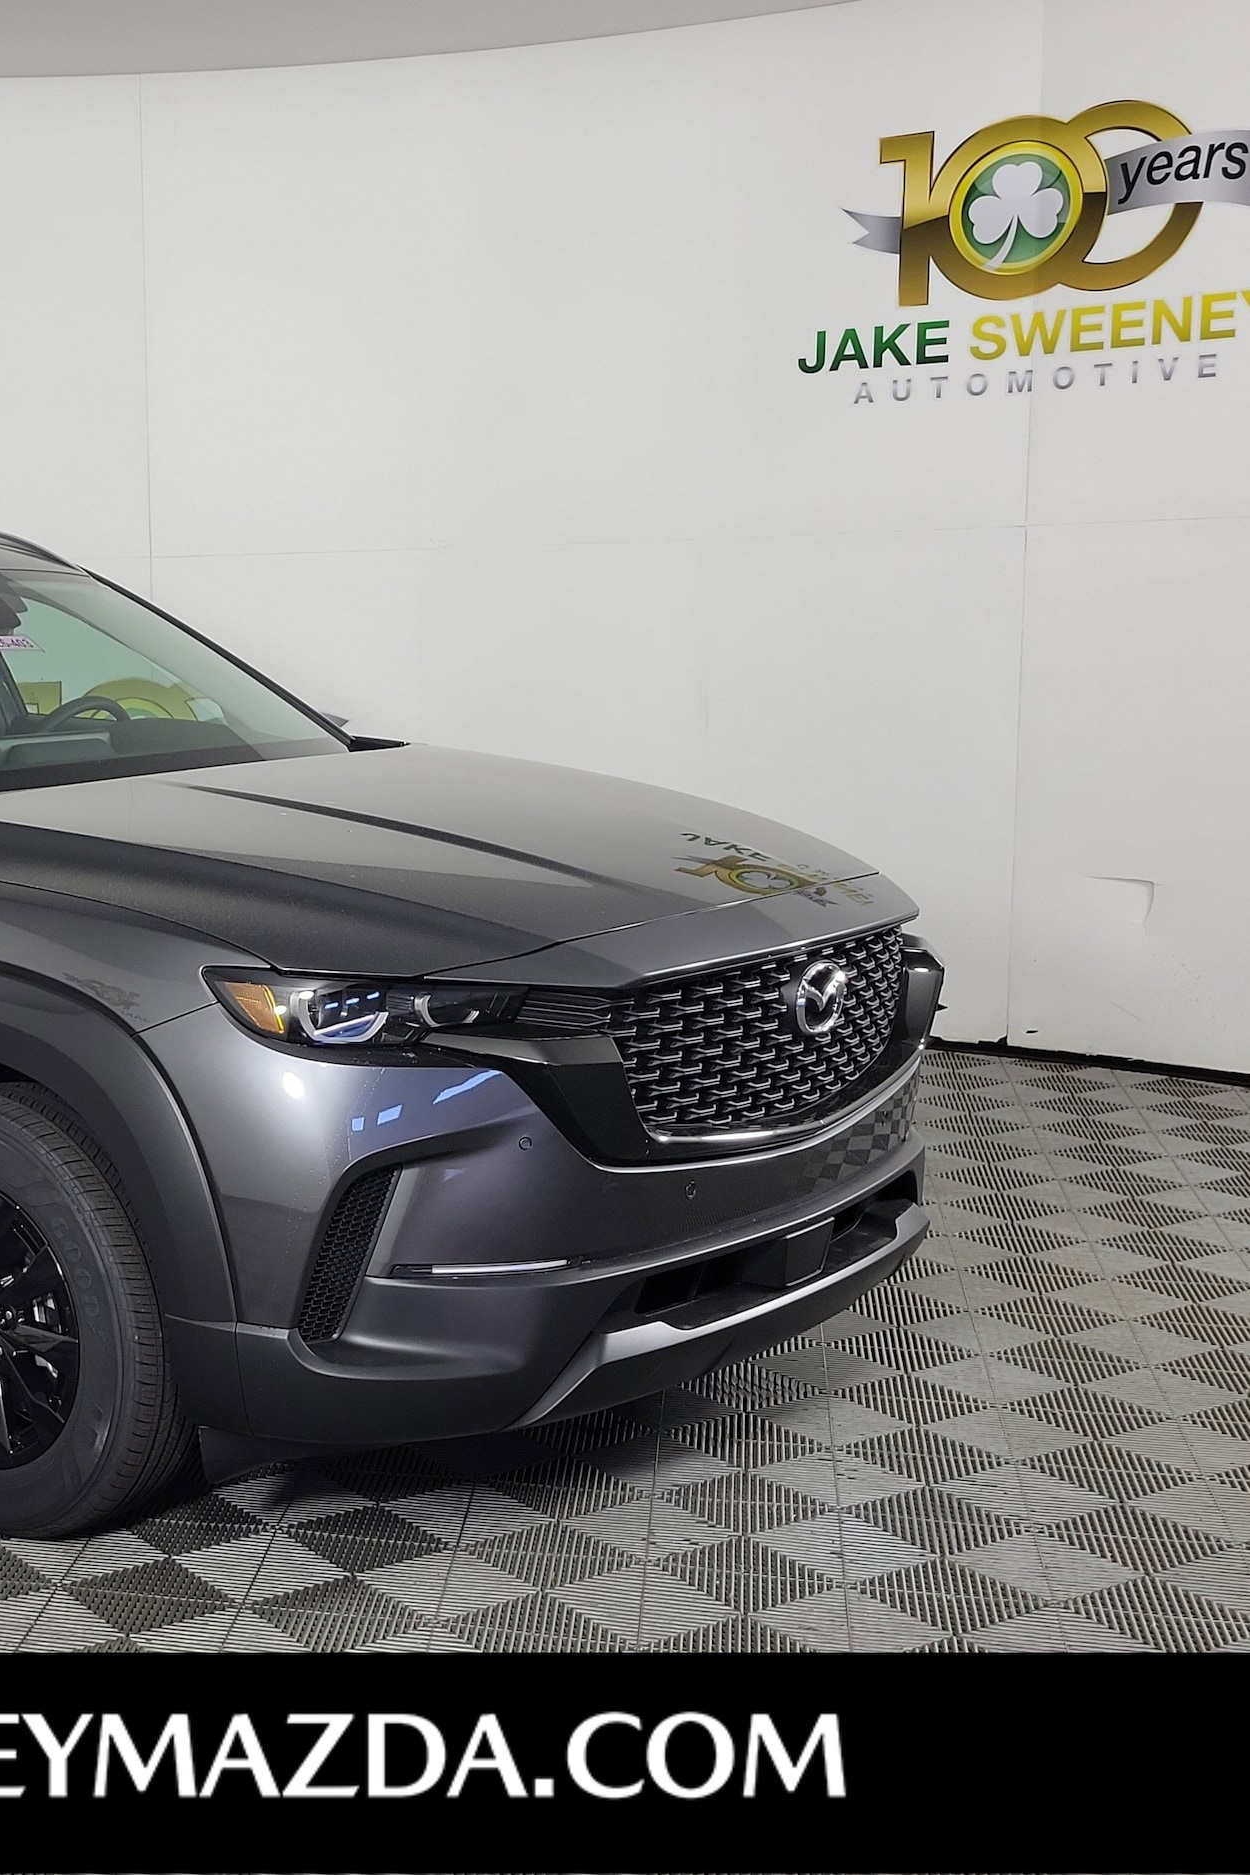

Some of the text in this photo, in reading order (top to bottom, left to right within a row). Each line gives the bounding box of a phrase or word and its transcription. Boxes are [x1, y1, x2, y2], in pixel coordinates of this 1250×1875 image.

[879, 98, 1204, 307] 100
[1118, 141, 1249, 204] years
[798, 290, 1250, 374] JAKE SWEENE
[853, 353, 1218, 405] AUTOMOTIVE
